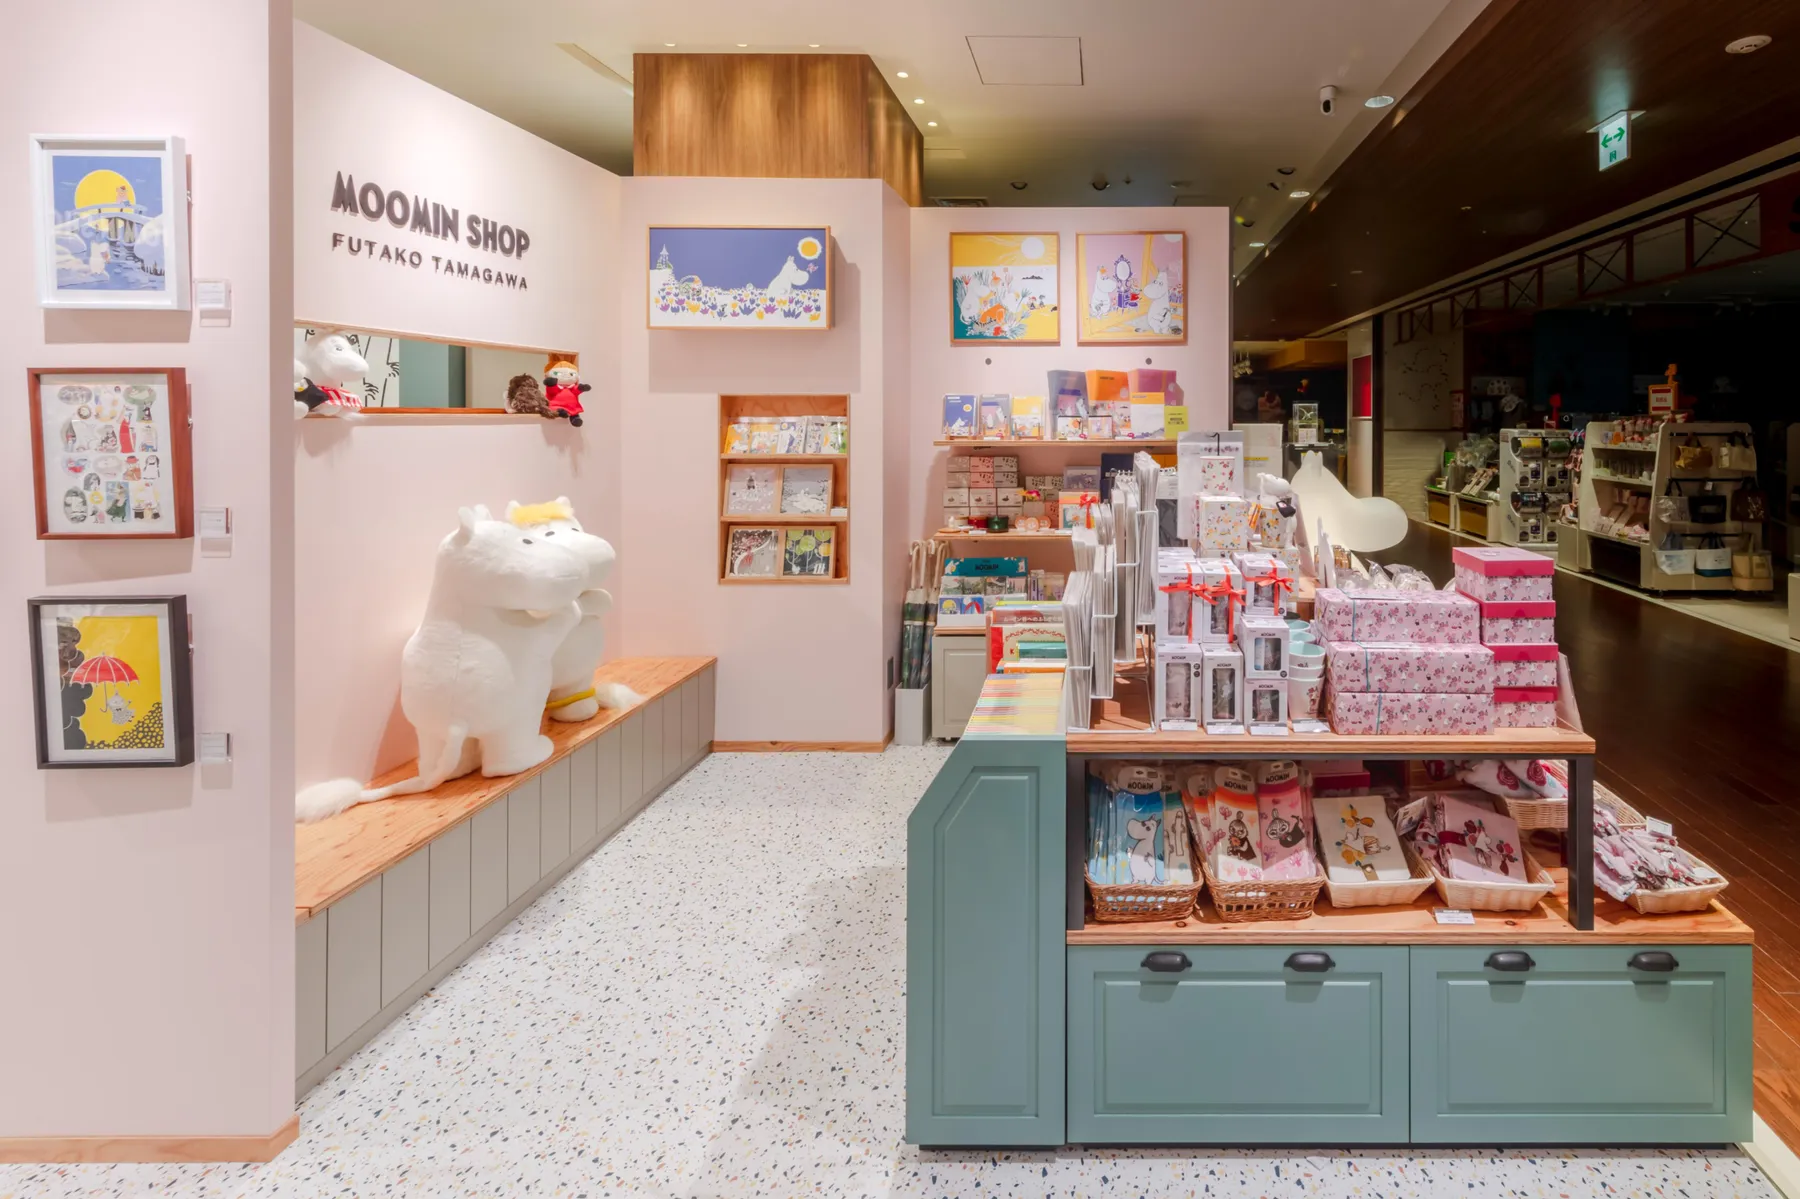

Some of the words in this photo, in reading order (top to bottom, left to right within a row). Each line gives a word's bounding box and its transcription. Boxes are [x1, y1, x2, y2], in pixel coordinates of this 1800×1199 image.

[331, 170, 459, 242] MOOMIN
[466, 214, 531, 259] SHOP
[331, 232, 423, 269] FUTAKO
[432, 255, 528, 290] TAMAGAWA
